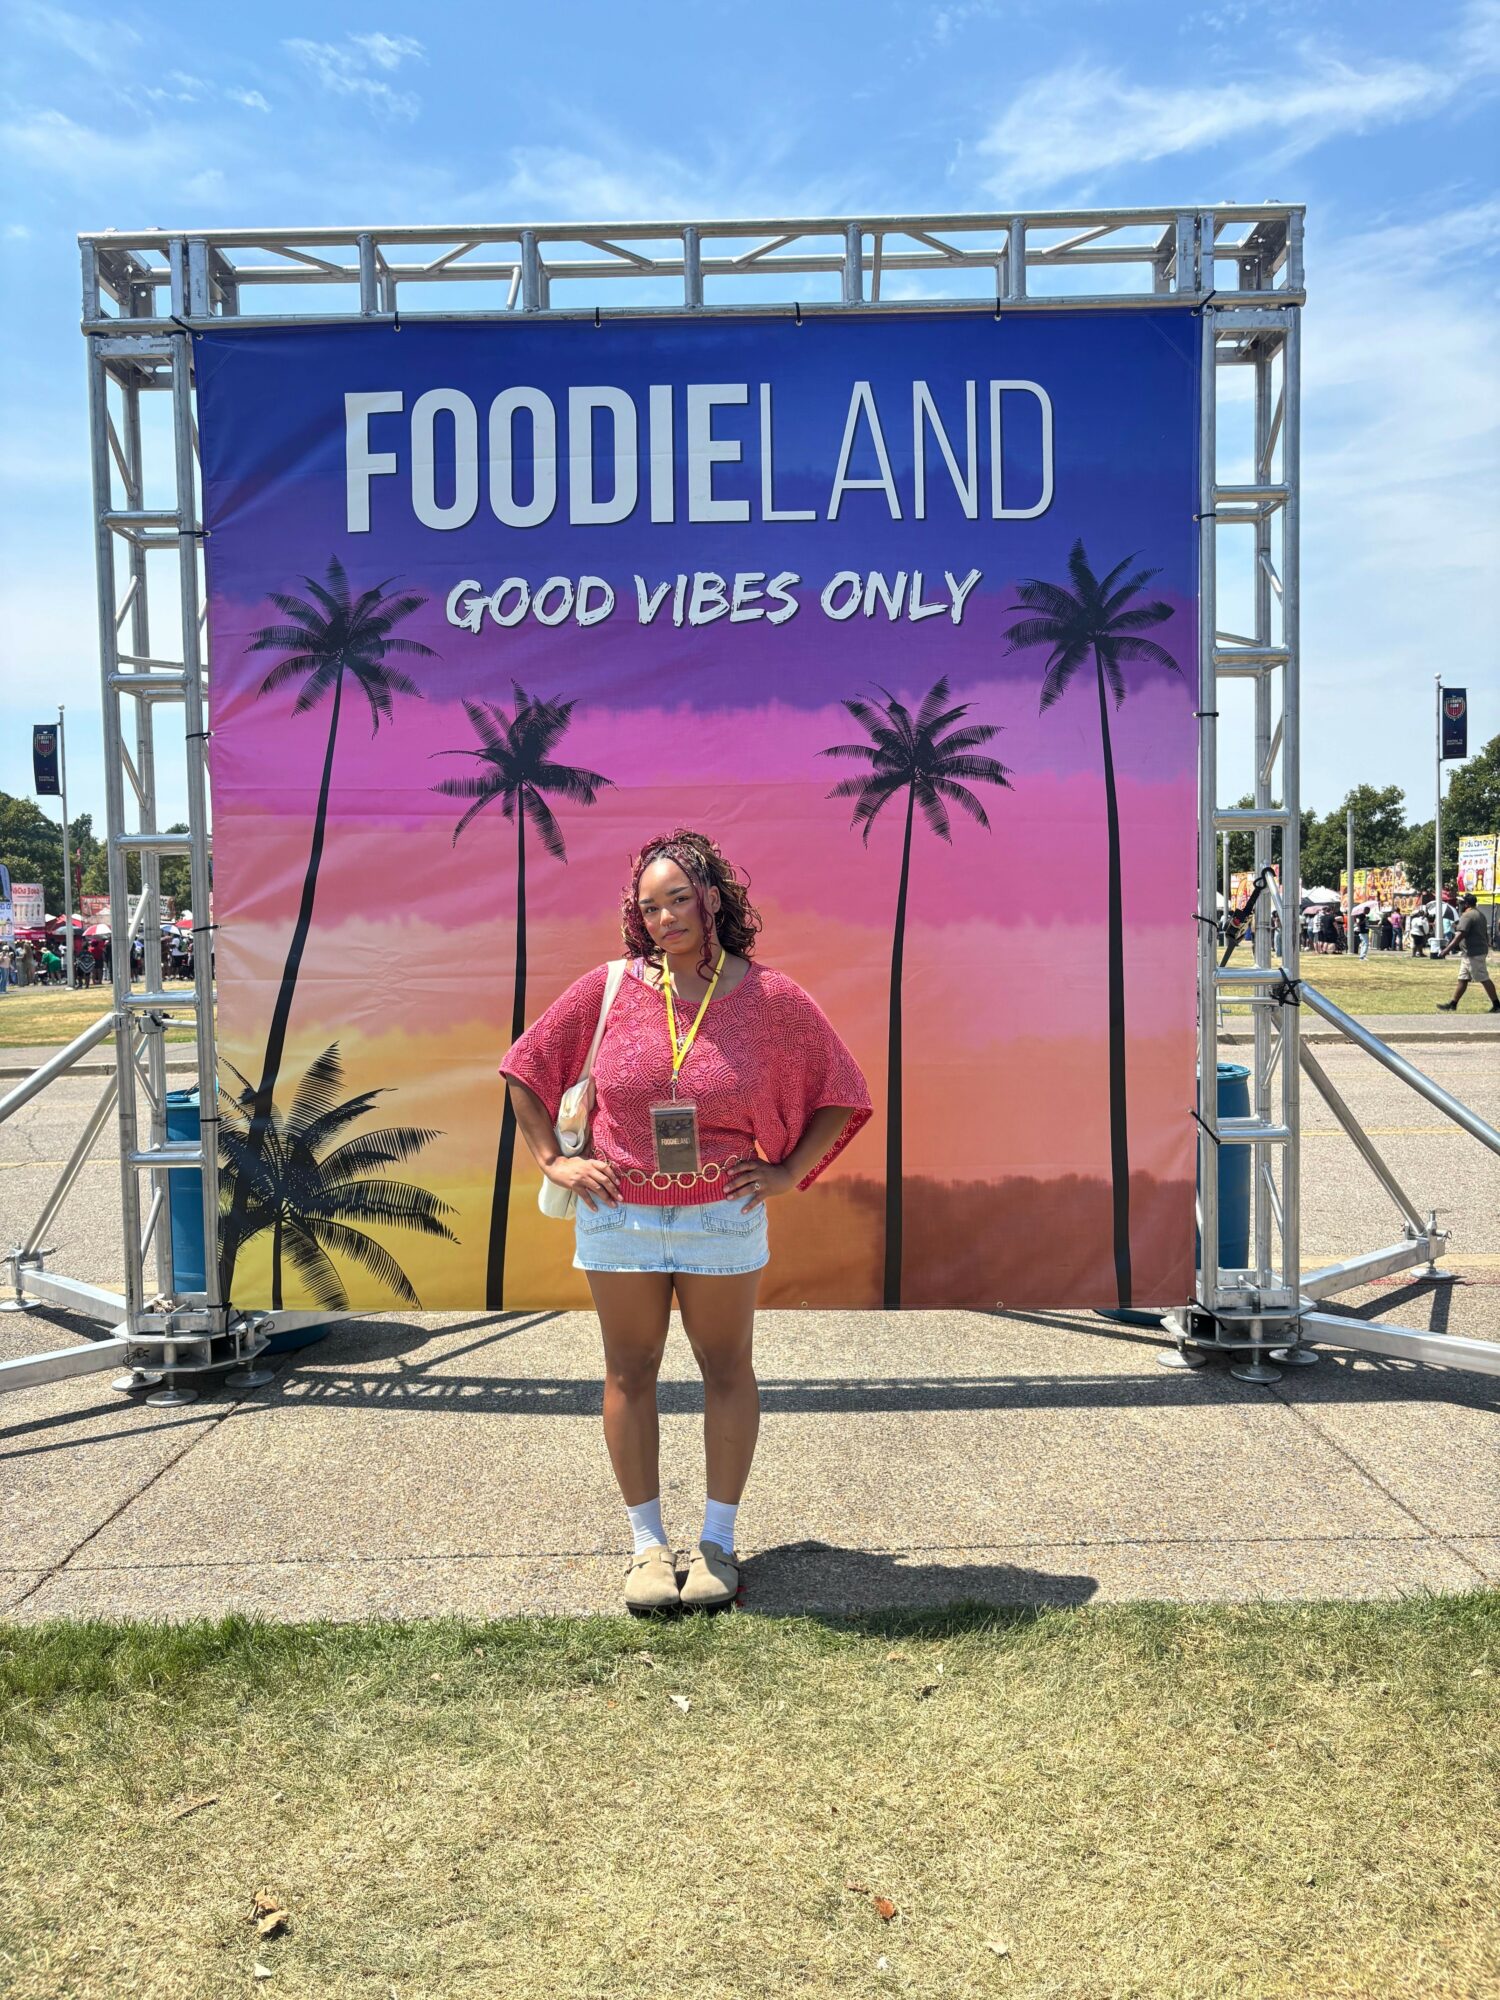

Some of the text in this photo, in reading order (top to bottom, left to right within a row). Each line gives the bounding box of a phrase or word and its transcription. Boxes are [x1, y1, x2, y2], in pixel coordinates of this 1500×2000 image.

[345, 381, 1052, 532] FOODIELAND
[447, 569, 981, 633] GOOD VIBES ONLY
